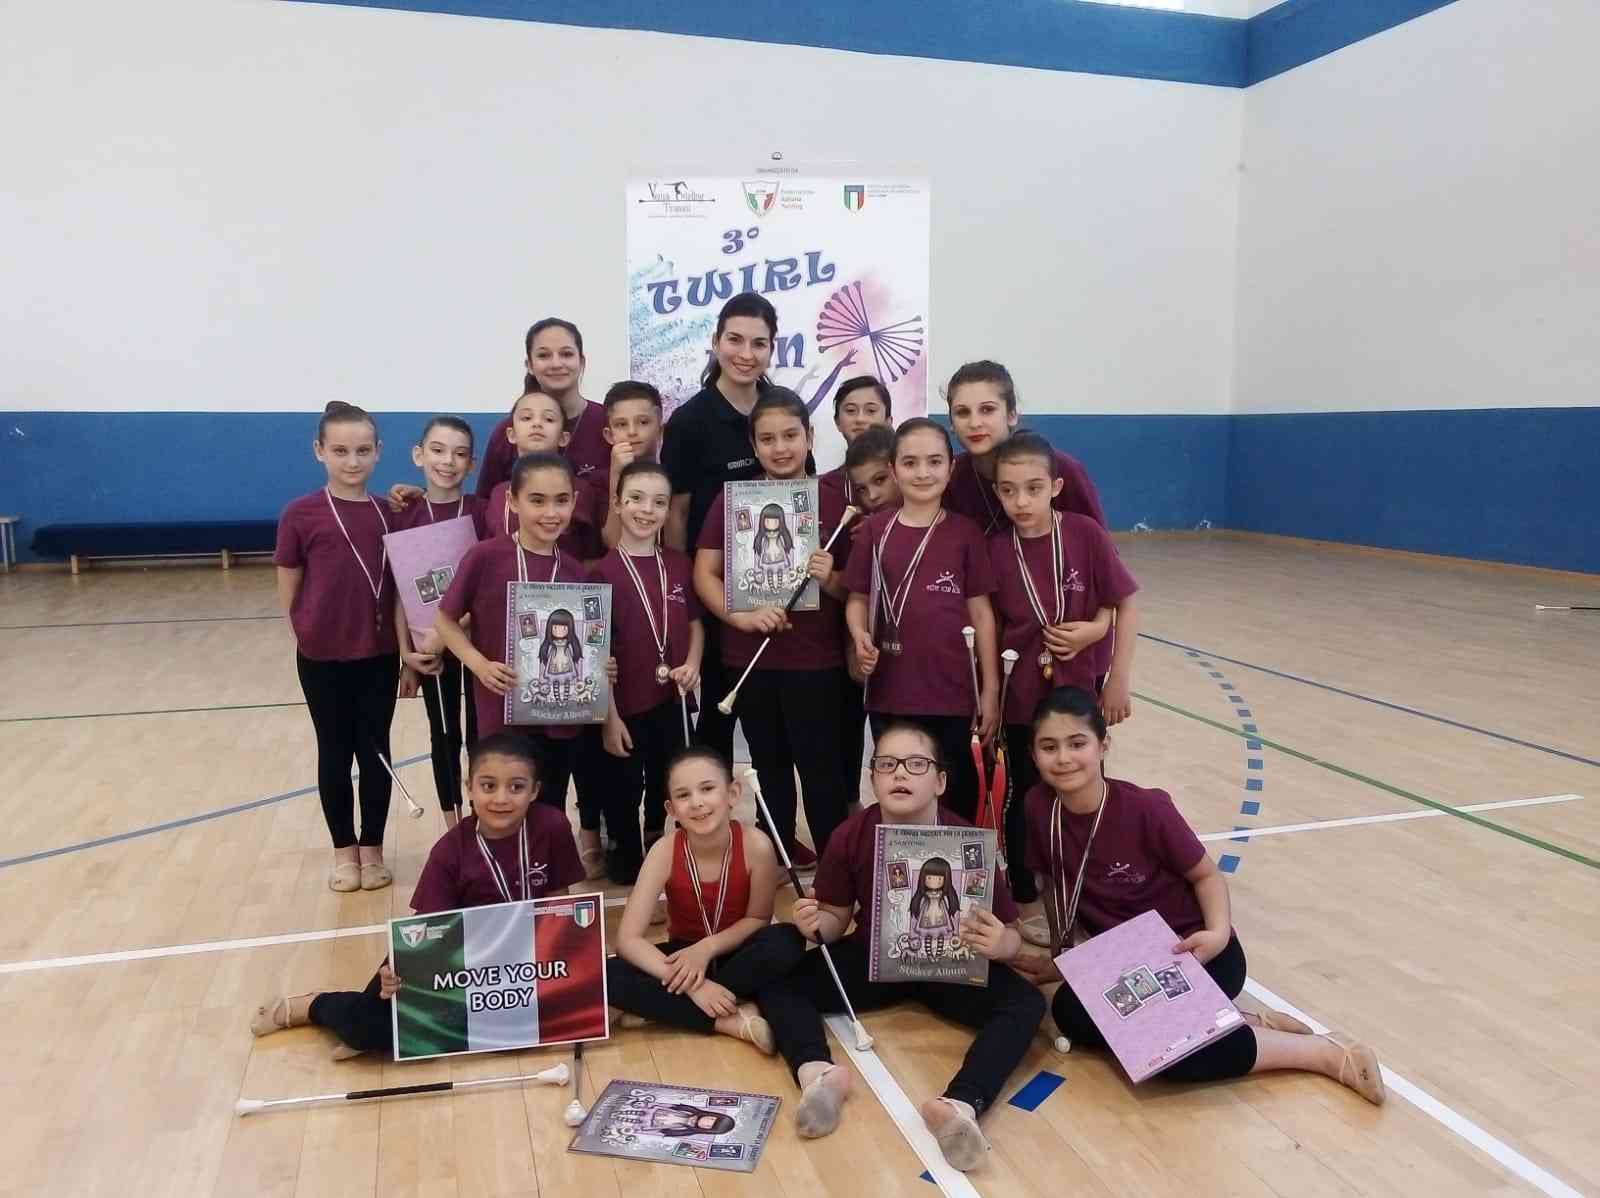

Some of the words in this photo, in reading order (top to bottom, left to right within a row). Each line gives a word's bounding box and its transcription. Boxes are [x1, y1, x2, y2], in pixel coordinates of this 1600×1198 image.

[721, 226, 760, 255] 3°
[647, 249, 836, 315] TWIRL
[433, 967, 500, 990] MOVE
[505, 960, 568, 983] YOUR
[471, 987, 533, 1012] BODY
